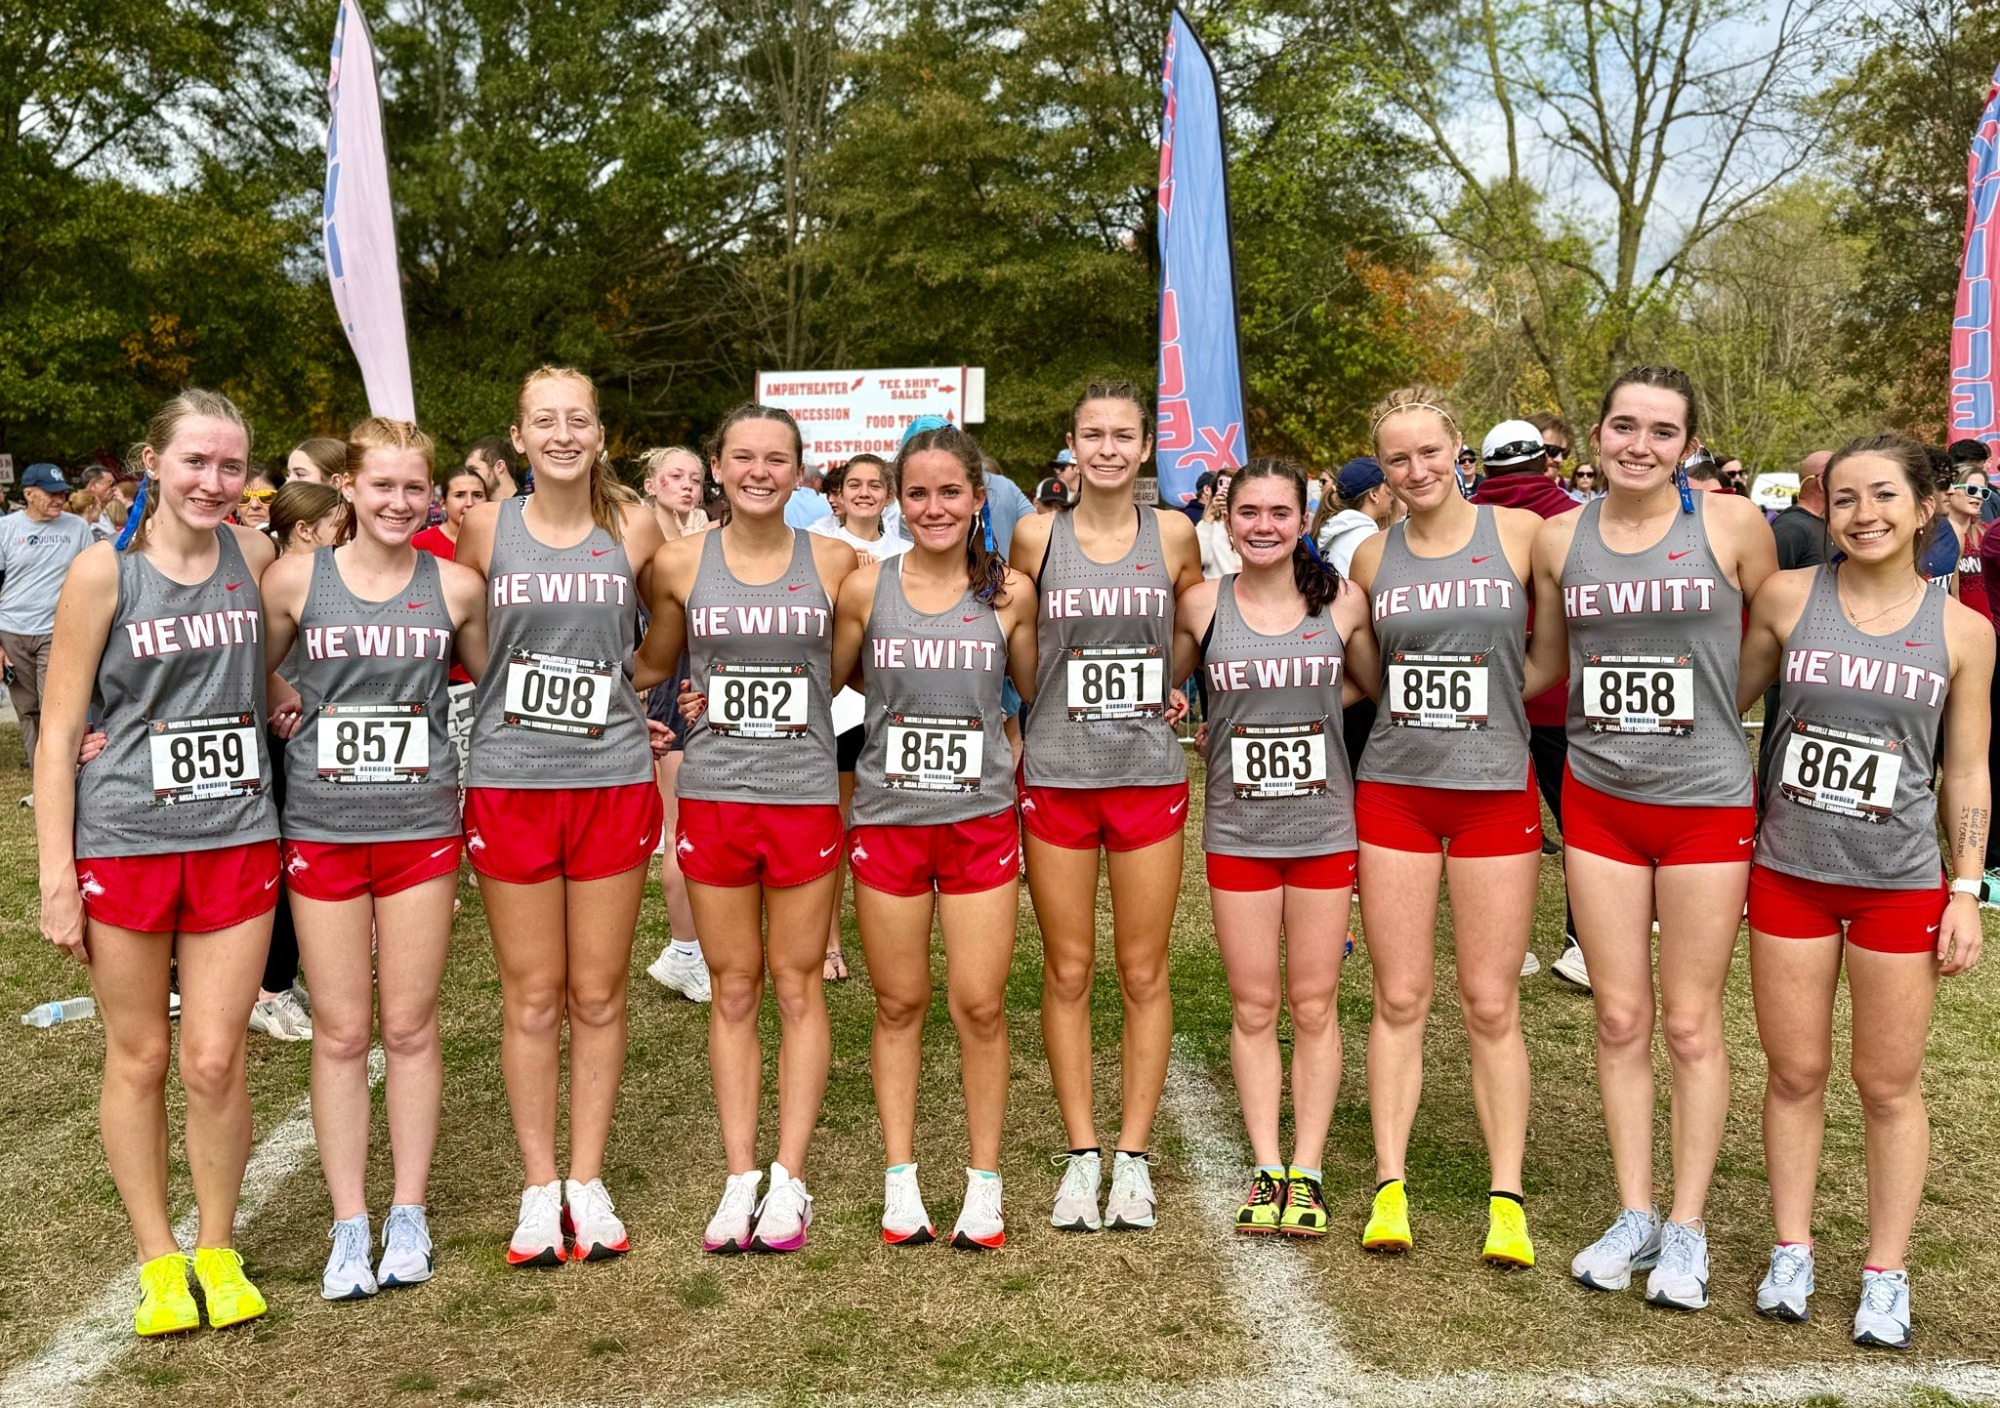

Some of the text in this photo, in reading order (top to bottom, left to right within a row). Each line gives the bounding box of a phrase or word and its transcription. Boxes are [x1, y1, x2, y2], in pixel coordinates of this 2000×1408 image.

[766, 382, 848, 396] AMPHITHEATER
[879, 378, 940, 389] TEE SHIRT
[891, 390, 927, 400] SALES
[786, 408, 850, 421] ONCESSION
[866, 415, 894, 428] FOOD
[814, 440, 901, 453] RESTROOMS
[493, 572, 627, 607] HEWITT
[1047, 586, 1168, 619] HEWITT
[1374, 578, 1515, 623] HEWITT
[1563, 577, 1716, 619] HEWITT
[125, 609, 259, 659] HEWITT
[691, 605, 828, 638] HEWITT
[304, 625, 450, 661] HEWITT
[871, 638, 996, 672] HEWITT
[1082, 662, 1144, 704] 861
[1208, 655, 1342, 692] HEWITT
[1403, 669, 1471, 712] 856
[1600, 671, 1675, 717] 858
[1785, 648, 1946, 708] HEWITT
[724, 679, 792, 721] 862
[170, 732, 244, 783] 859
[336, 721, 411, 765] 857
[901, 731, 967, 775] 855
[1246, 740, 1312, 781] 863
[1798, 741, 1879, 801] 864
